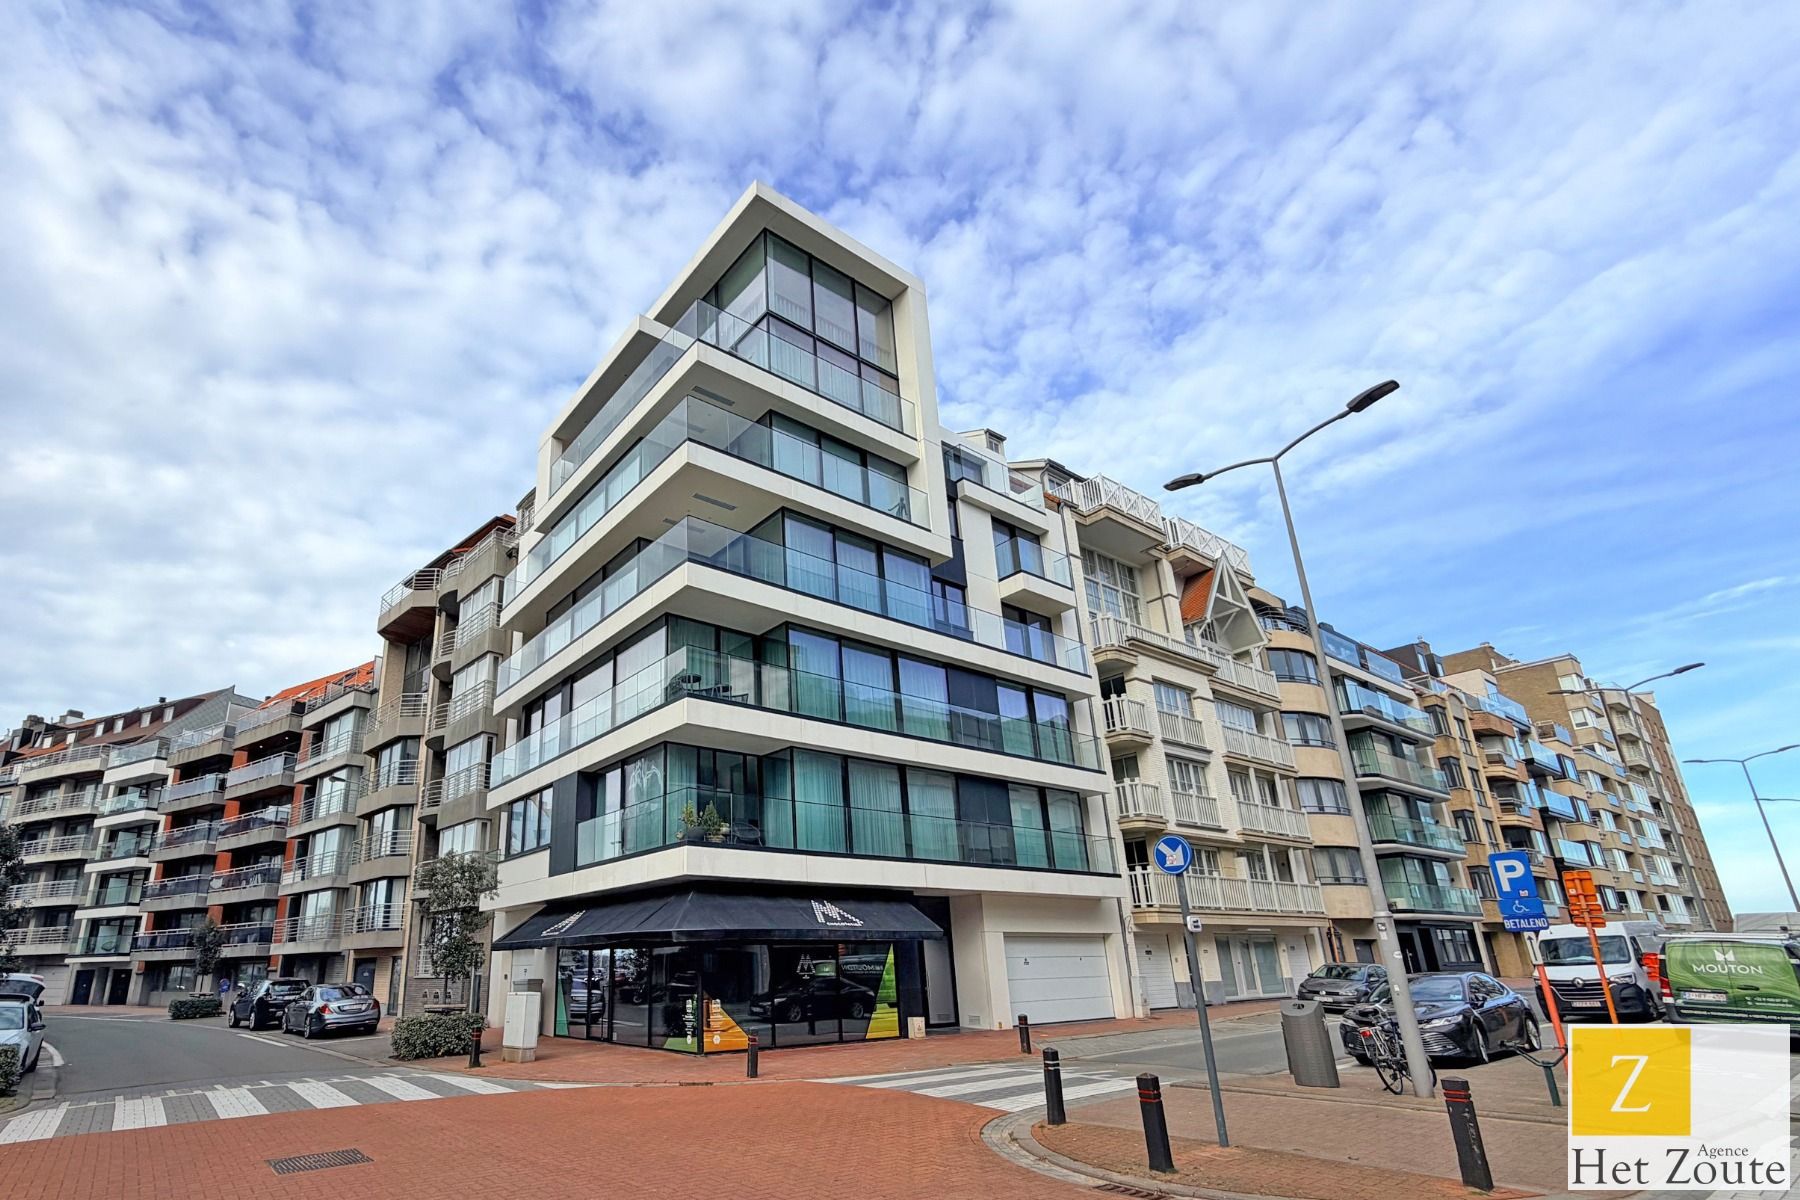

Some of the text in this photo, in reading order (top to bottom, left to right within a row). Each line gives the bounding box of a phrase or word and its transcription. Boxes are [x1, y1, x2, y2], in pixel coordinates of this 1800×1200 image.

[1495, 859, 1525, 892] P
[1503, 918, 1548, 929] BETALEND
[1692, 964, 1763, 974] MOUTON
